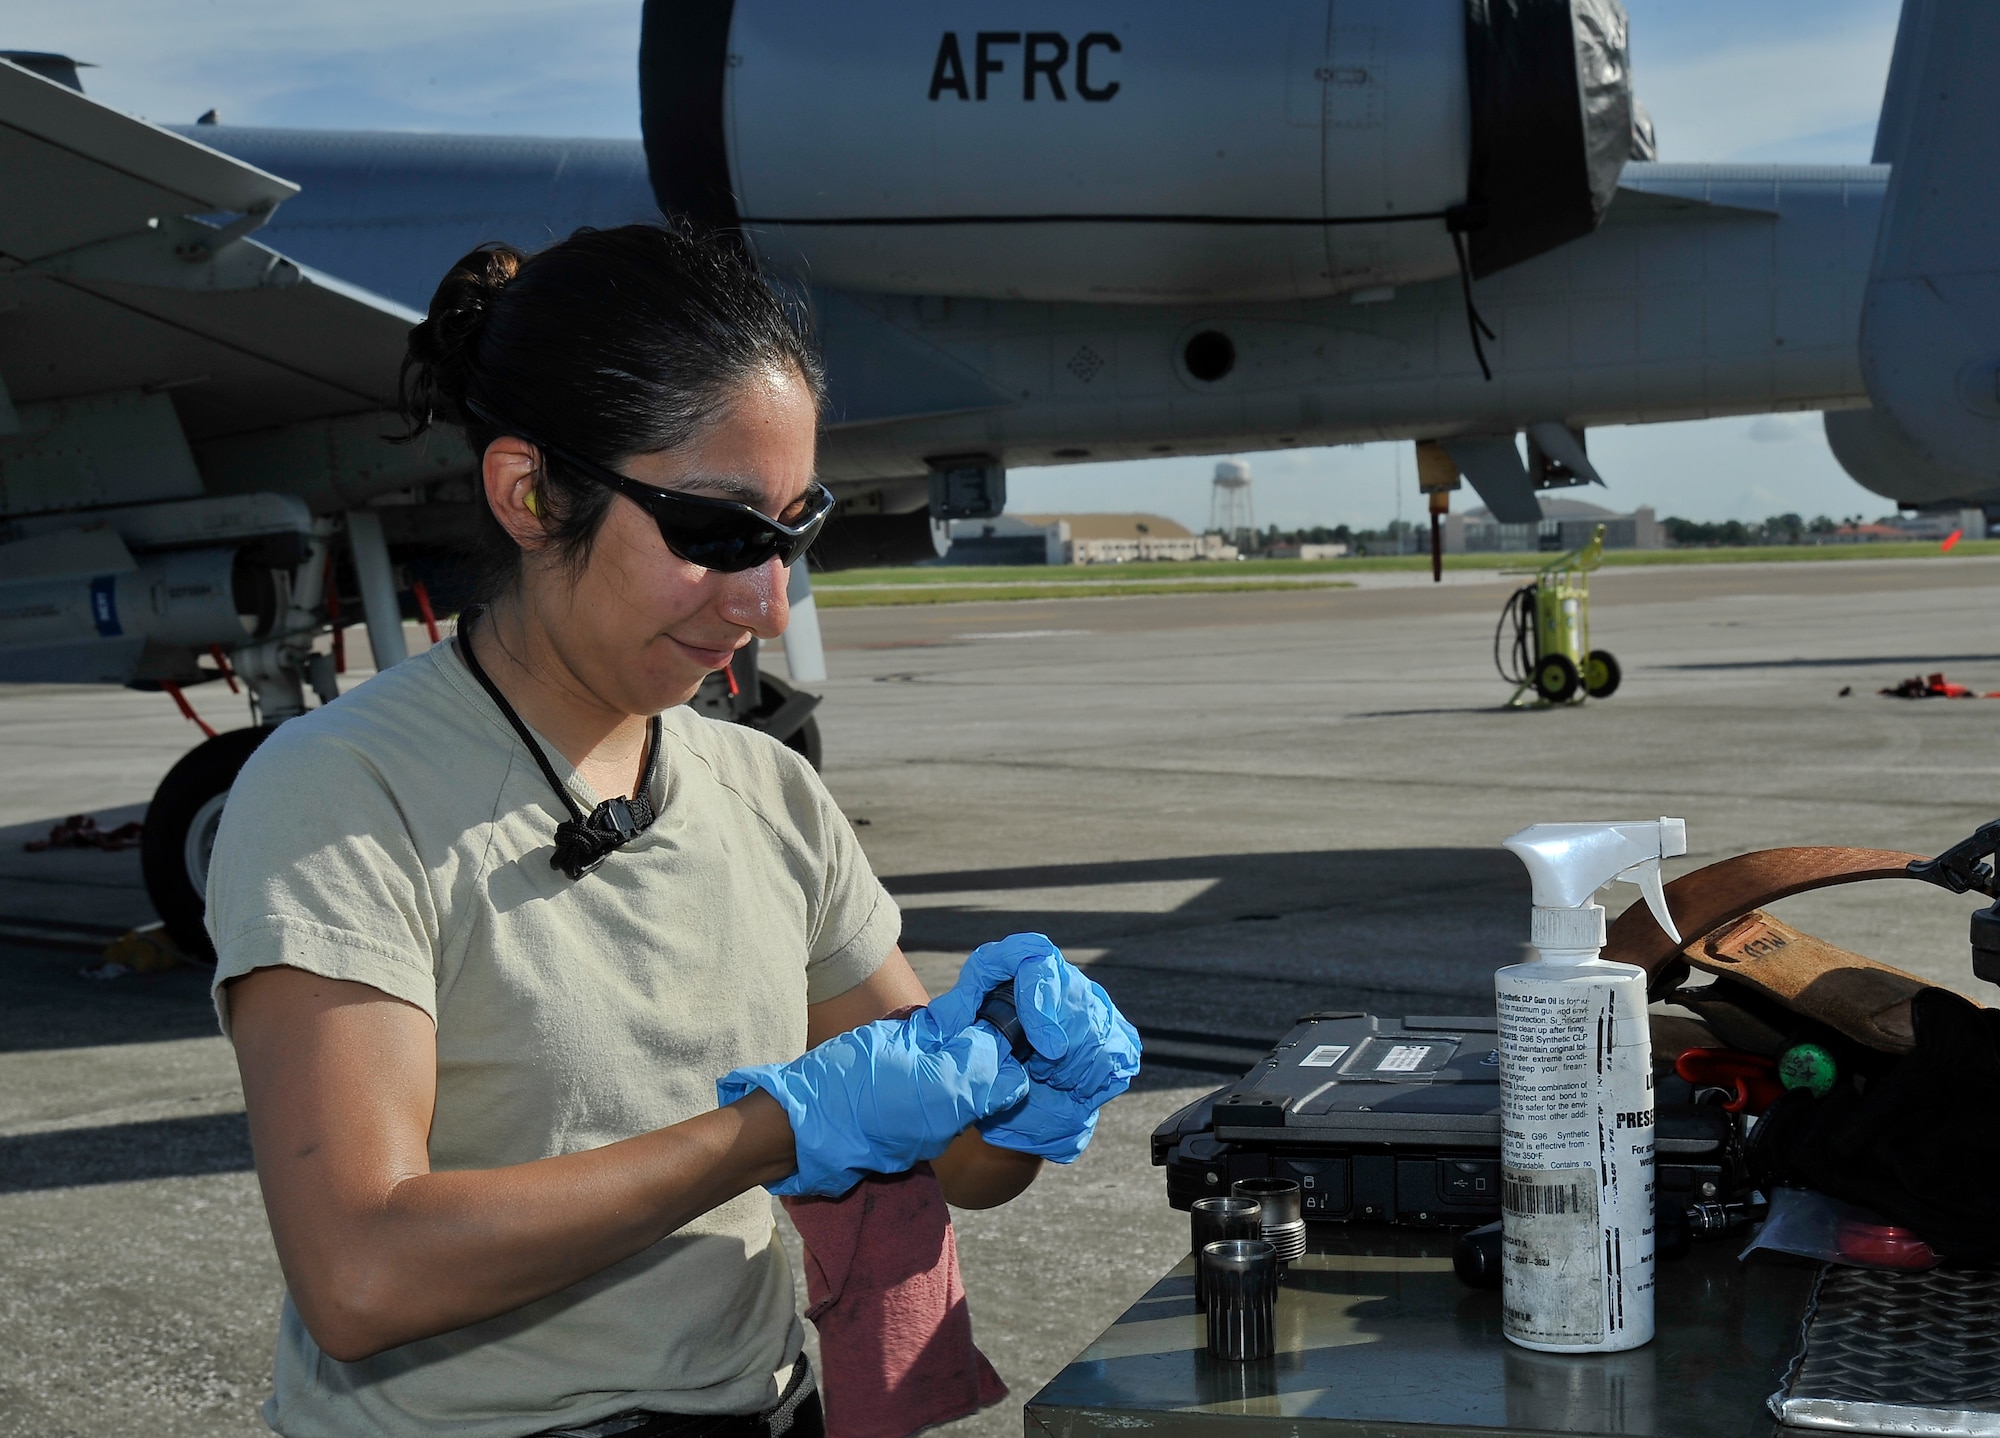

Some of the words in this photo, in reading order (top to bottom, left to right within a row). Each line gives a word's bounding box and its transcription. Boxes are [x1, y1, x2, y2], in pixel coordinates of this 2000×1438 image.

[928, 31, 1122, 102] AFRC
[1534, 996, 1546, 1004] Gun
[1511, 1005, 1540, 1014] maximum
[1515, 1015, 1548, 1024] protection.
[1519, 1025, 1536, 1033] clean
[1538, 1027, 1547, 1035] up
[1550, 1026, 1566, 1034] after
[1568, 1025, 1586, 1034] firing.
[1520, 1034, 1534, 1042] G96
[1536, 1034, 1570, 1045] Synthetic
[1572, 1033, 1588, 1042] CLP
[1519, 1044, 1548, 1053] maintain
[1550, 1044, 1574, 1054] original
[1576, 1043, 1587, 1051] tol-
[1512, 1054, 1528, 1062] under
[1566, 1053, 1587, 1061] condi-
[1518, 1064, 1535, 1073] keep
[1542, 1065, 1558, 1074] your
[1514, 1082, 1536, 1092] Unique
[1538, 1082, 1579, 1092] combination
[1580, 1081, 1588, 1089] of
[1514, 1094, 1536, 1102] protect
[1542, 1094, 1556, 1102] and
[1560, 1092, 1576, 1100] bond
[1558, 1102, 1569, 1110] the
[1571, 1101, 1588, 1109] envi-
[1550, 1112, 1568, 1120] other
[1571, 1111, 1588, 1119] addi-
[1532, 1132, 1548, 1140] G96
[1558, 1130, 1590, 1140] Synthetic
[1516, 1141, 1524, 1149] Oil
[1526, 1142, 1532, 1150] is
[1536, 1142, 1566, 1150] effective
[1568, 1140, 1584, 1148] from
[1632, 1145, 1644, 1155] For
[1550, 1161, 1579, 1169] Contains
[1584, 1160, 1592, 1168] no
